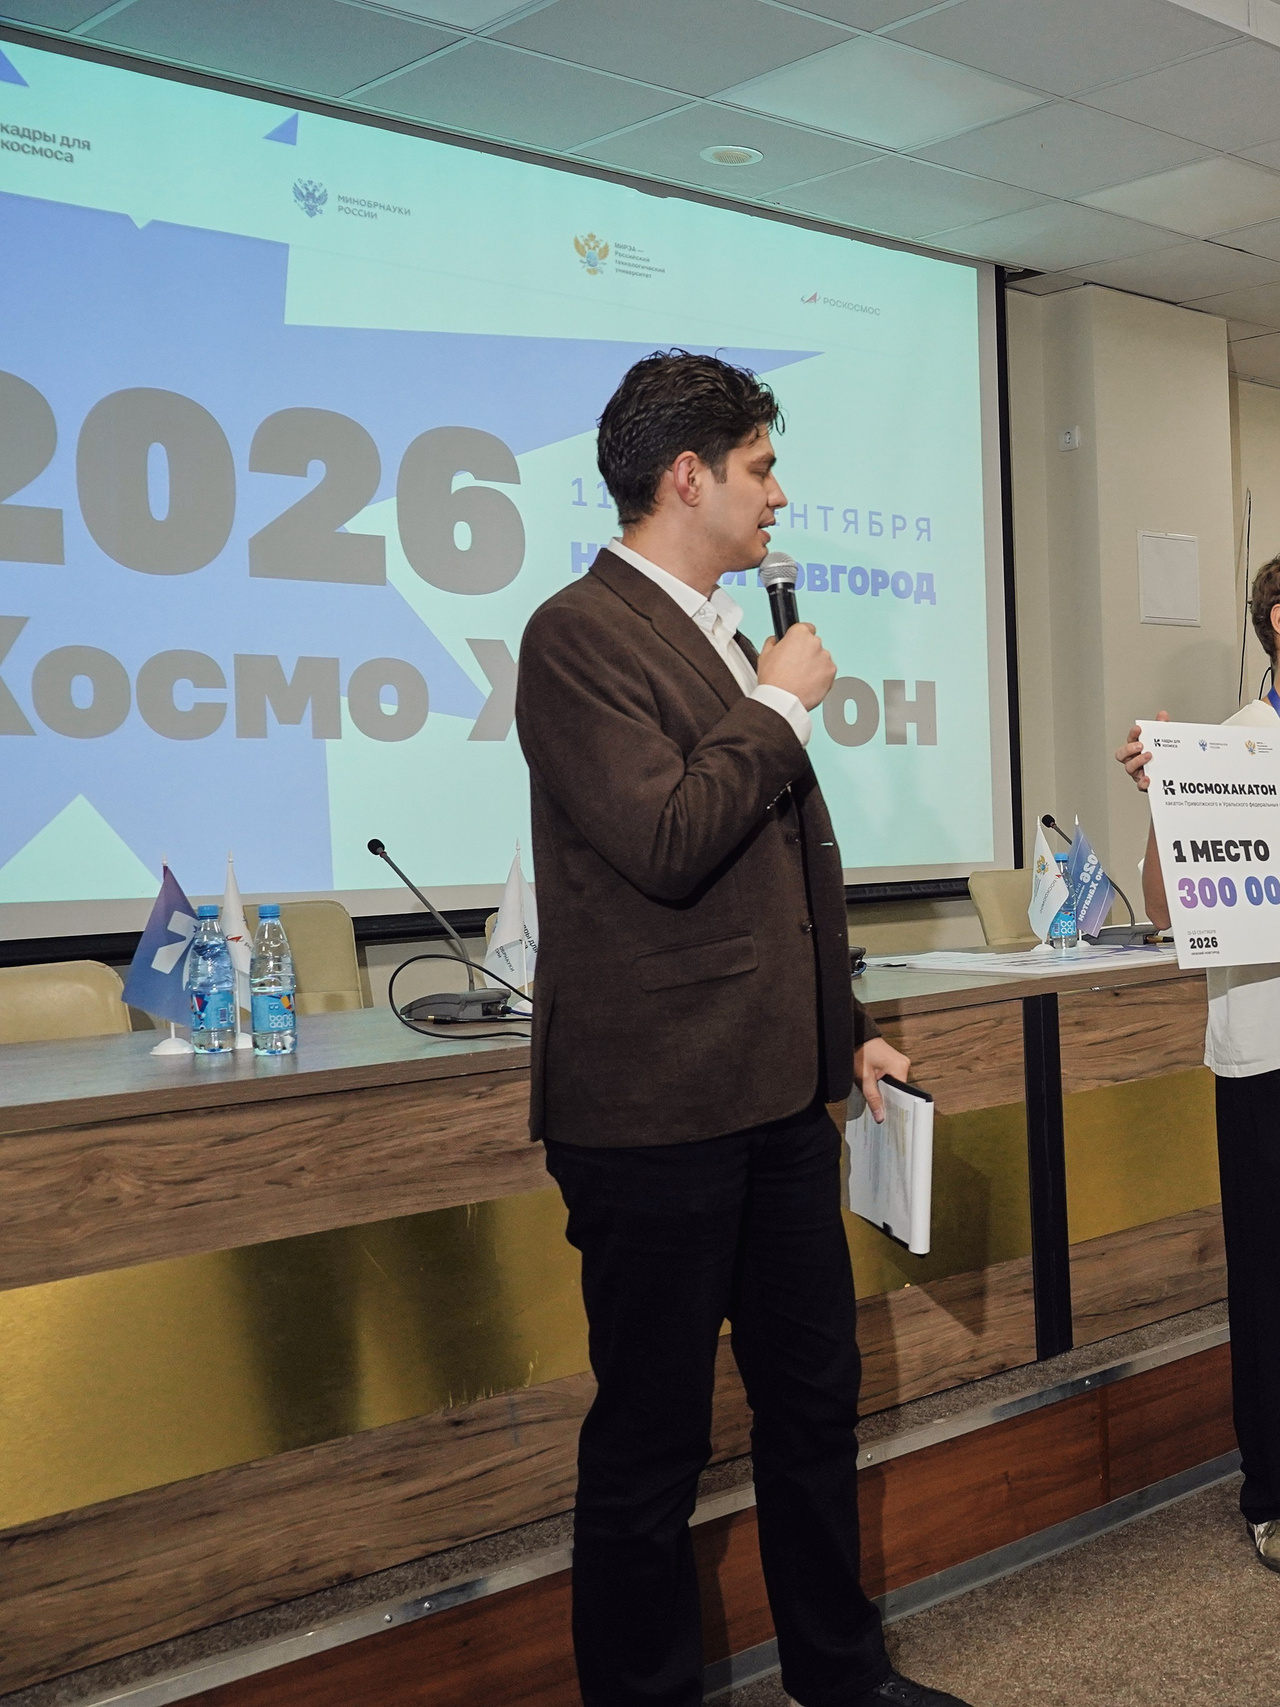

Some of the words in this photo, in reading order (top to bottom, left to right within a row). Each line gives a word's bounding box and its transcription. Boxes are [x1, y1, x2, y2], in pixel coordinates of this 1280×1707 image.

[0, 123, 56, 143] кадры
[59, 135, 91, 151] для
[0, 139, 74, 163] космоса
[338, 194, 411, 216] МИНОБРНАУКИ
[338, 205, 378, 219] РОССИИ
[823, 297, 880, 316] РОСКОСМОС
[774, 502, 932, 542] НТЯБРЯ
[757, 561, 937, 605] ВГОРОД
[1180, 782, 1277, 796] КОСМОХАКАТОН
[1172, 840, 1187, 862] 1
[1190, 840, 1270, 862] МЕСТО
[1178, 876, 1238, 909] 300
[1190, 936, 1218, 949] 2026
